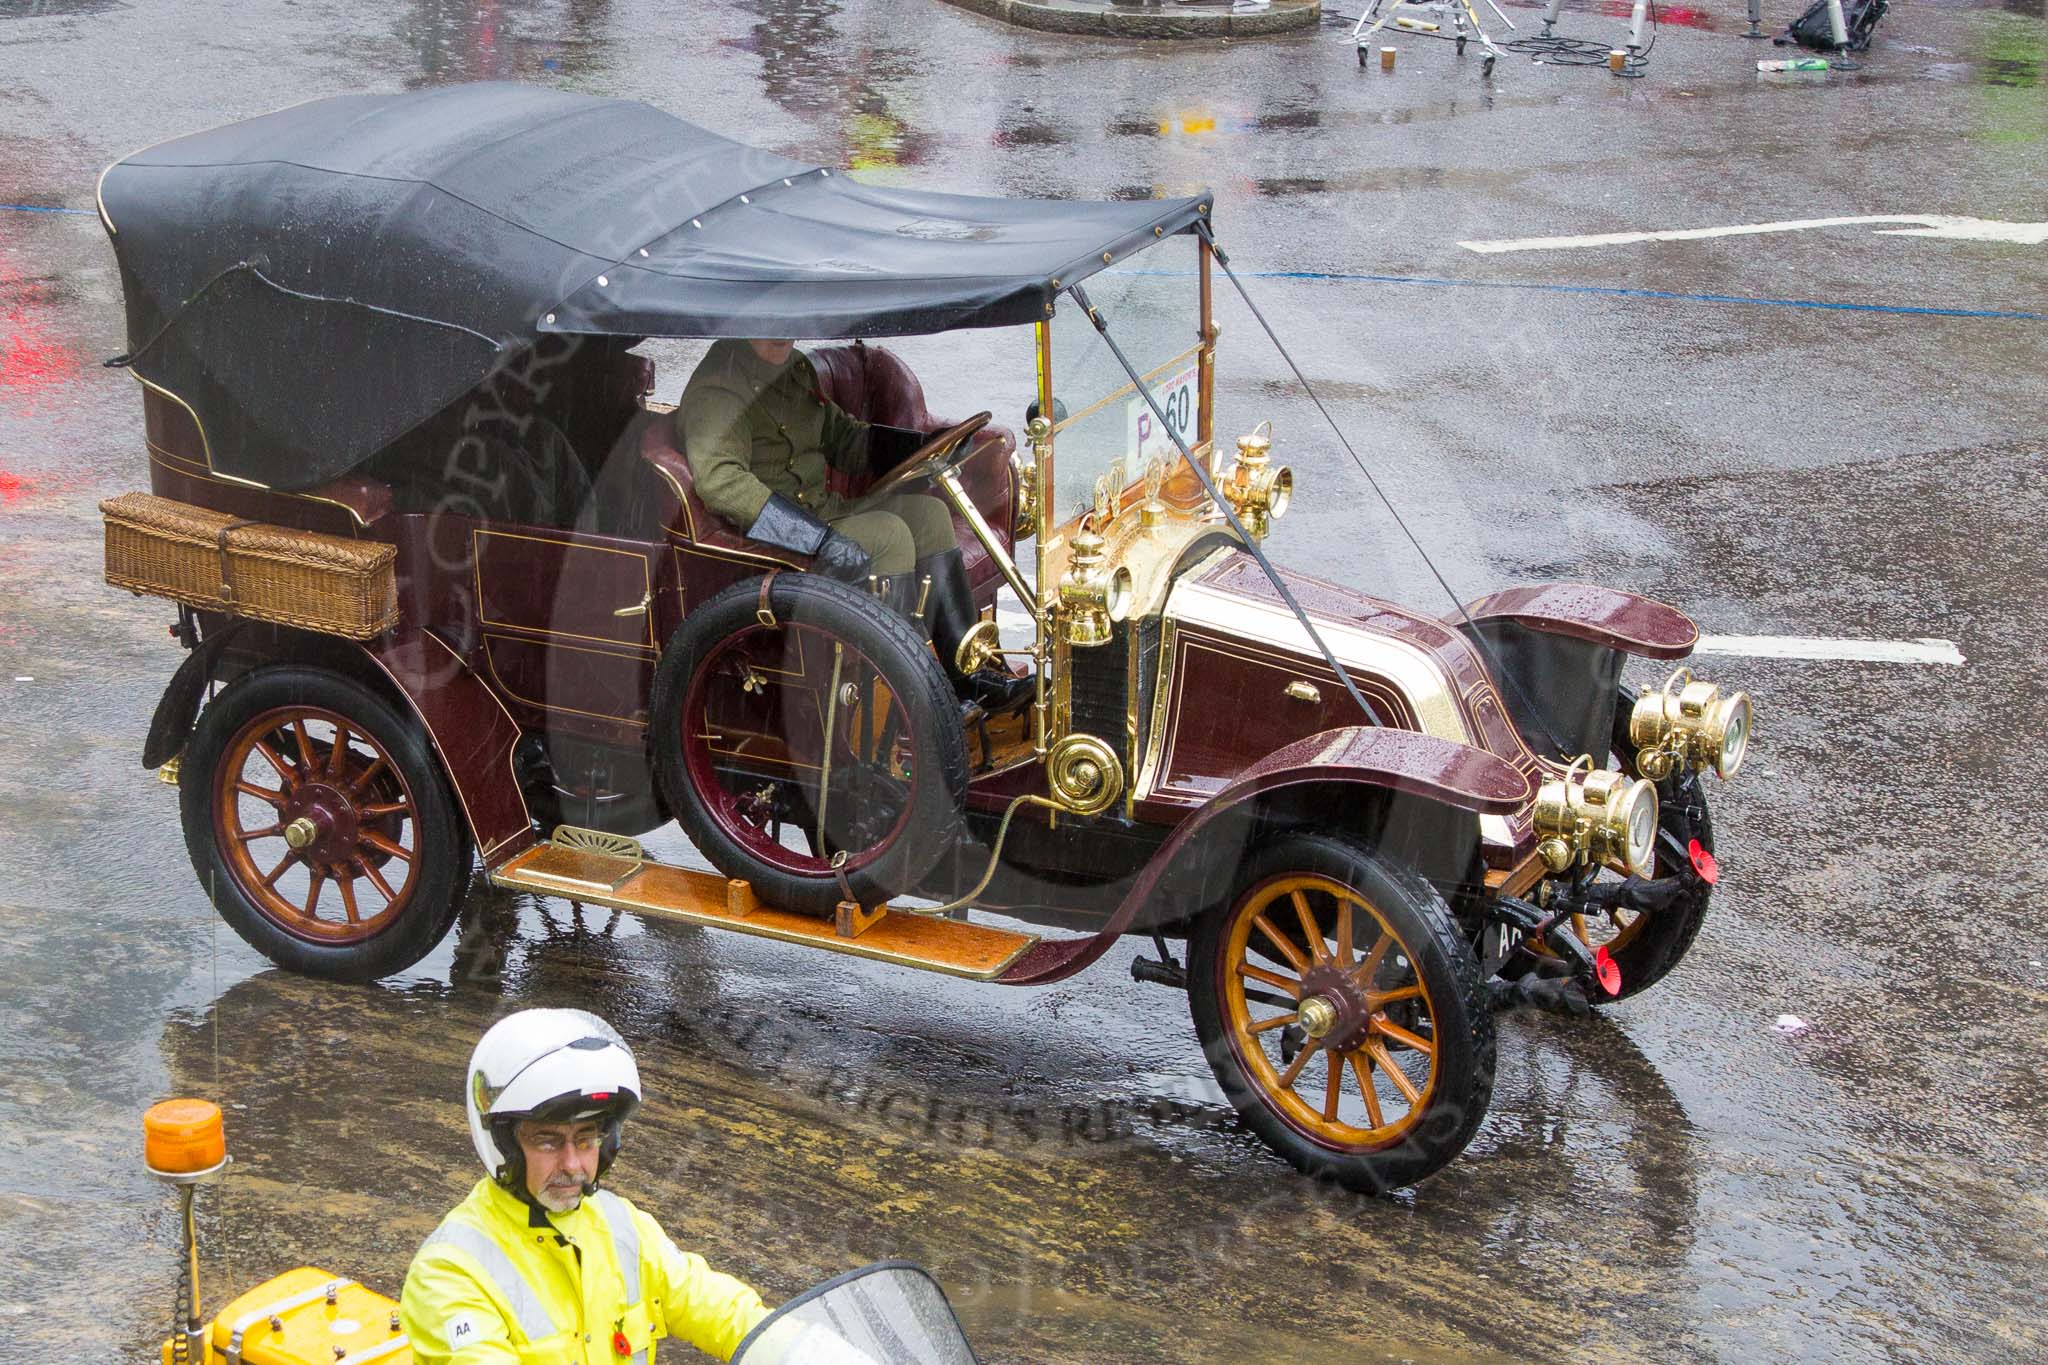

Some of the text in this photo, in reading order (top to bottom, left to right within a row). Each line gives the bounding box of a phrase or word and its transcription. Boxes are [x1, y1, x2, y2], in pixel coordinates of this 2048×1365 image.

[1138, 412, 1151, 458] P
[1165, 384, 1189, 441] 60
[456, 1322, 471, 1338] AA
